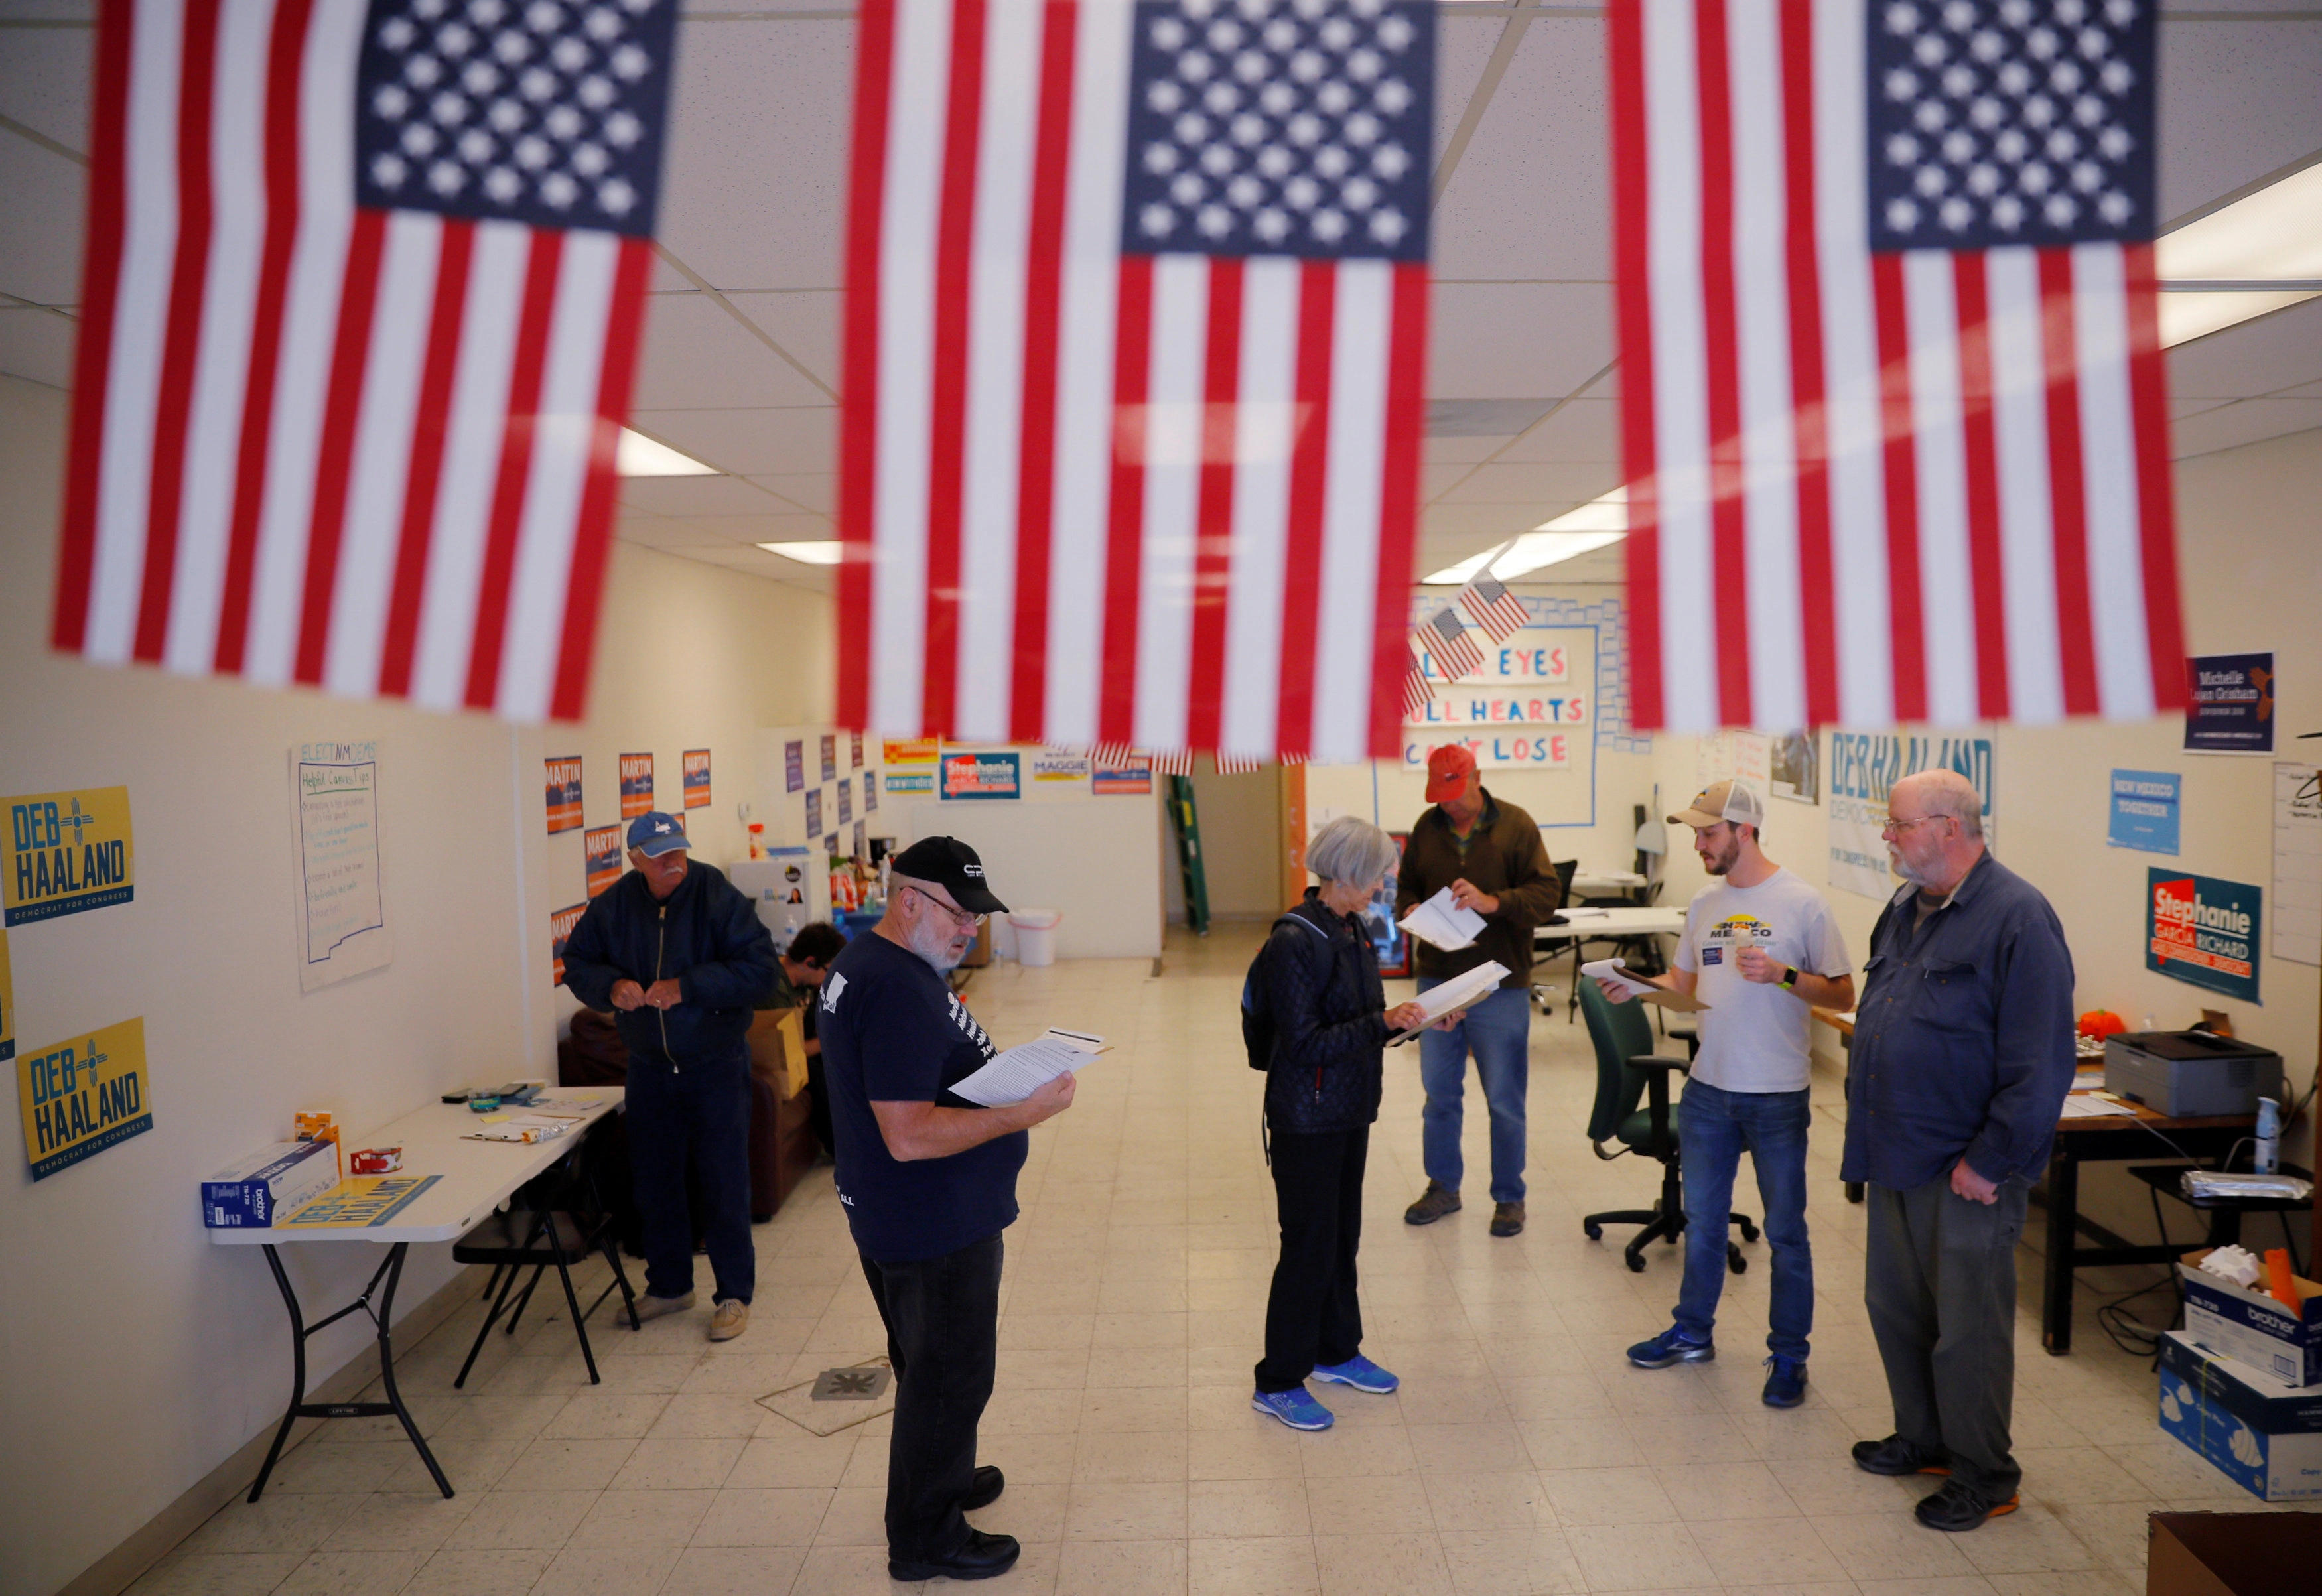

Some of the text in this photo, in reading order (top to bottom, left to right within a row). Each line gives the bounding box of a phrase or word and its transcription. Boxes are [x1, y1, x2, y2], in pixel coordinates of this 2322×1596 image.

[1500, 648, 1564, 675] EYES
[2199, 670, 2244, 686] Michelle
[2215, 687, 2258, 700] Grisham
[1410, 698, 1582, 722] ULL HEARTS
[1494, 735, 1566, 762] LOSE
[621, 759, 652, 777] MARTIN
[948, 759, 1015, 775] Stephanie
[1034, 760, 1088, 771] MAGGIE
[1832, 732, 1870, 799] DEB
[12, 801, 61, 852] DEB
[587, 832, 622, 855] MARTIN
[16, 840, 125, 901] HAALAND
[15, 892, 127, 919] DEMOCRAT FOR CONGRESS
[2155, 888, 2251, 933] Stephanie
[552, 911, 586, 939] MART
[2154, 923, 2195, 947] GARCIA
[2197, 933, 2249, 959] RICHARD
[30, 1048, 77, 1106] DEB
[34, 1071, 141, 1154] HAALAND
[40, 1121, 146, 1173] DEMOCRAT FOR CONGRESS
[255, 1189, 265, 1221] brother
[289, 1204, 348, 1224] DEB
[330, 1179, 419, 1222] HAALAND
[2247, 1305, 2296, 1334] brother
